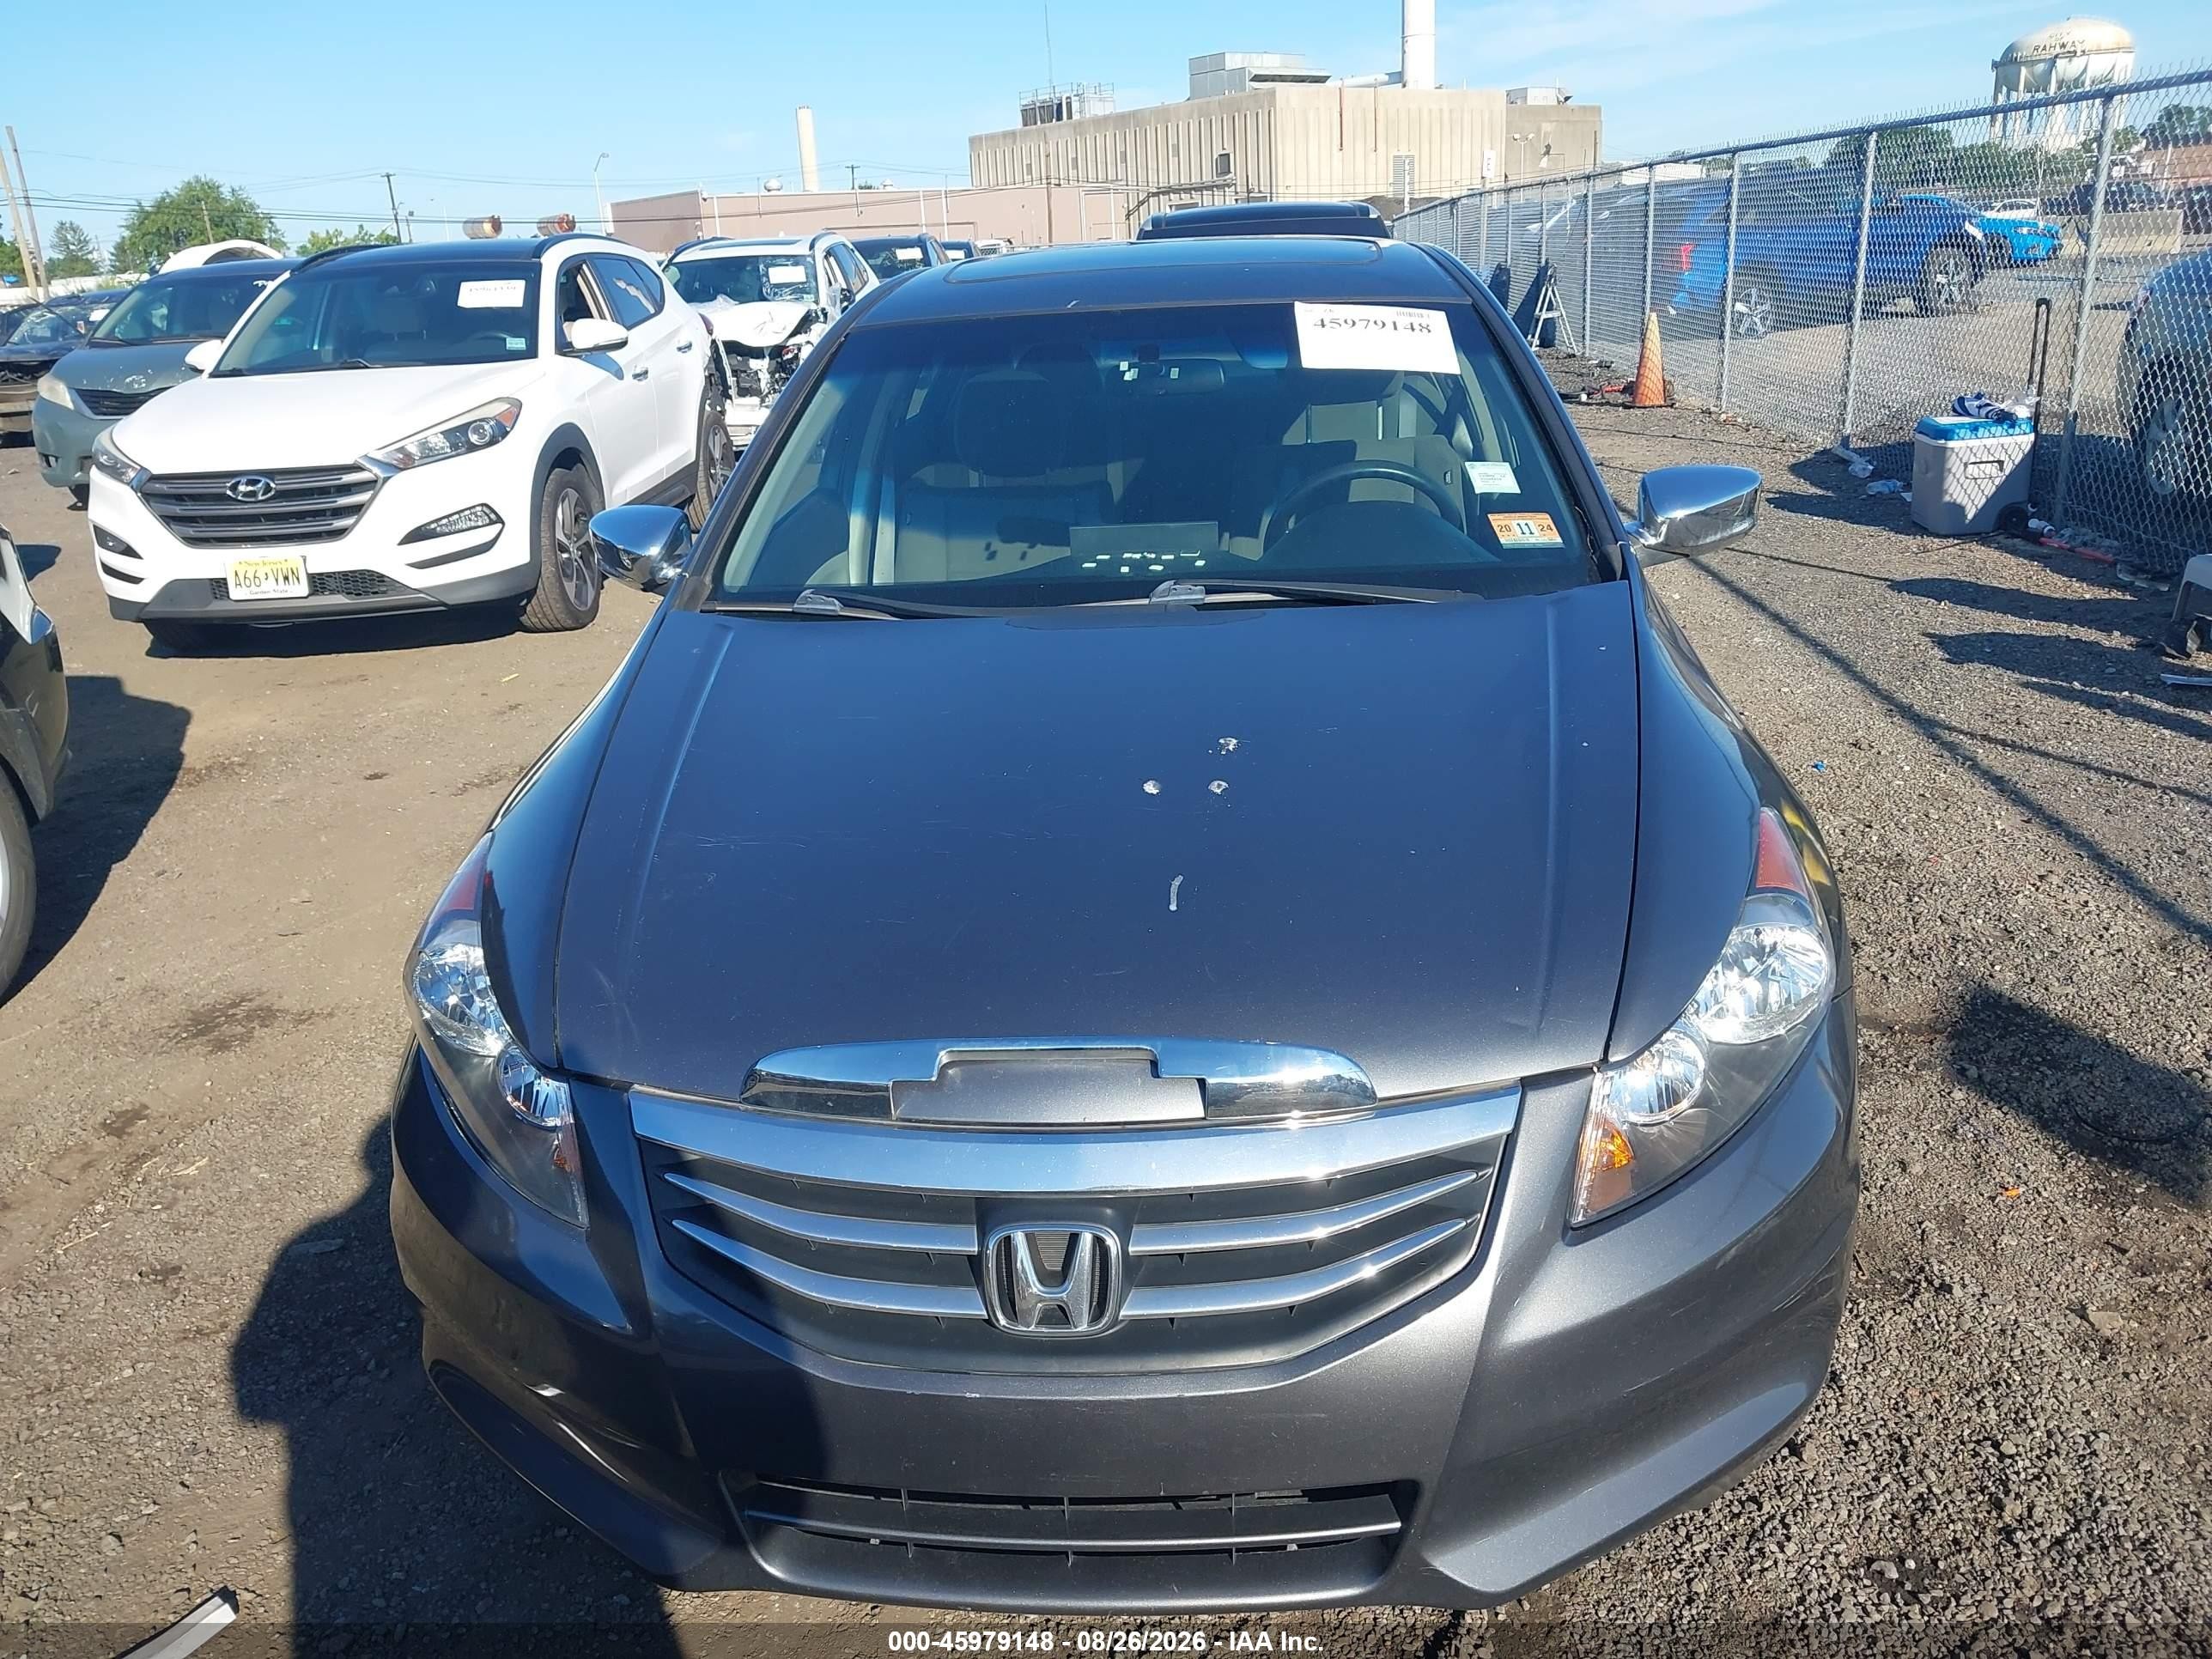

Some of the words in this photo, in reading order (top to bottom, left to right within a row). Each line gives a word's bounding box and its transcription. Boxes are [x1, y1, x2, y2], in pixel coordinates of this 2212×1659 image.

[2032, 39, 2086, 54] RAHWAY
[1313, 317, 1432, 334] 45979148
[1497, 524, 1512, 533] 20
[1516, 522, 1535, 535] 11
[1537, 524, 1553, 532] 24
